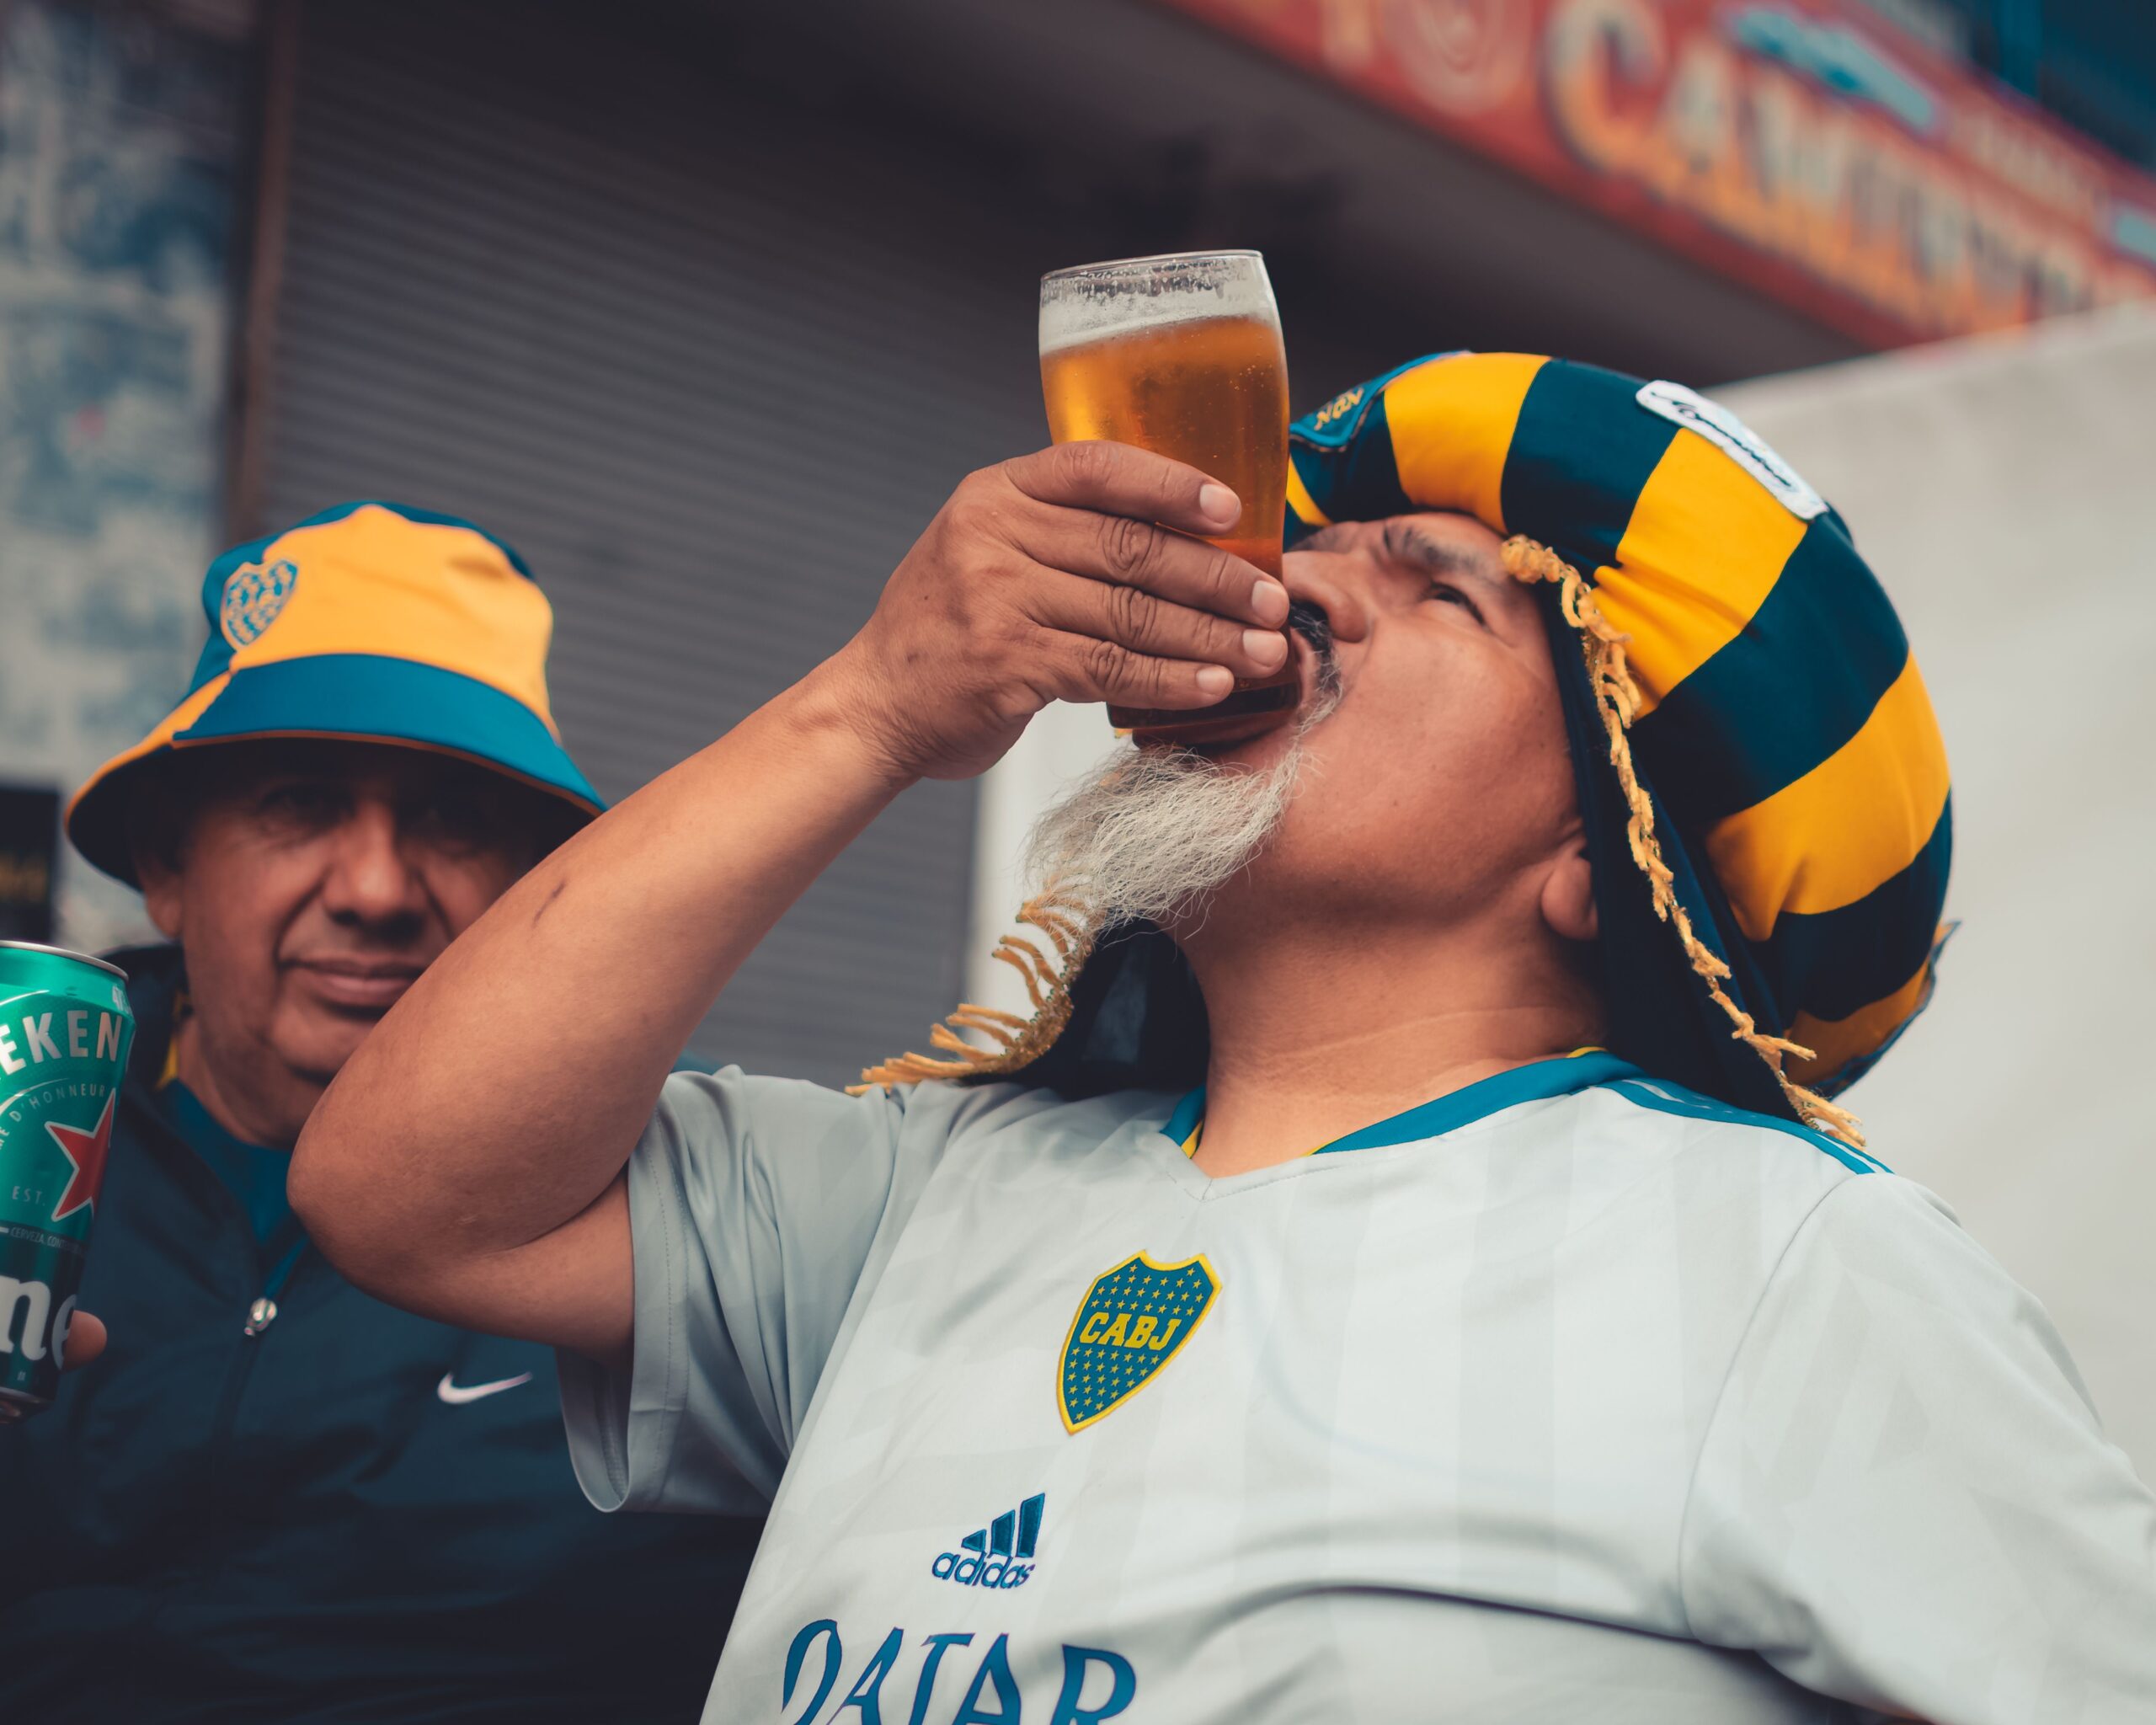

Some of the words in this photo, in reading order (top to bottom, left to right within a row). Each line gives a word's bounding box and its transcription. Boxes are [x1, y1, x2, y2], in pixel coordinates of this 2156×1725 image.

[0, 1010, 122, 1076] EKEN
[12, 1185, 45, 1207] EST.
[10, 1226, 45, 1246] CERVEZA
[1079, 1311, 1182, 1351] CABJ
[931, 1551, 1036, 1589] adidas
[782, 1619, 1136, 1725] QATAR
